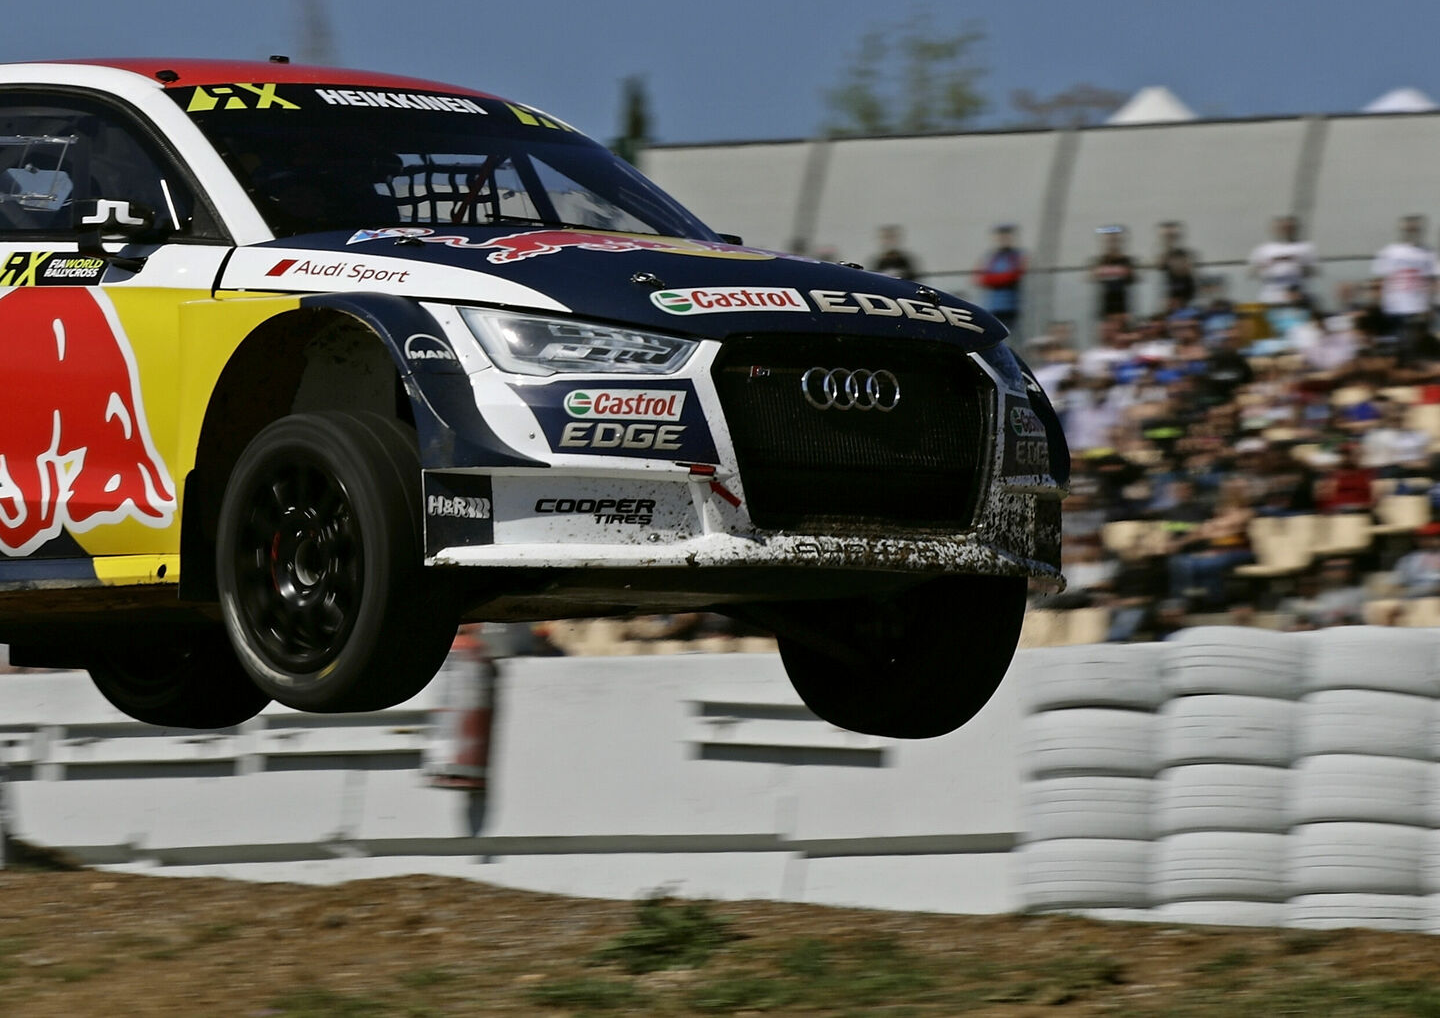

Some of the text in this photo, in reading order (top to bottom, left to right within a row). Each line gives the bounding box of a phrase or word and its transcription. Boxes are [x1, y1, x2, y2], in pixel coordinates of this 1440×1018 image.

[314, 88, 489, 115] HEIKKINEN
[43, 268, 100, 278] RALLYCROSS
[293, 260, 411, 283] Audi Sport
[690, 289, 985, 333] Castrol EDGE
[410, 350, 455, 360] MAN
[593, 392, 678, 416] Castrol
[559, 421, 688, 451] EDGE
[427, 494, 474, 517] H&R
[534, 498, 657, 514] COOPER
[594, 513, 653, 525] TIRES
